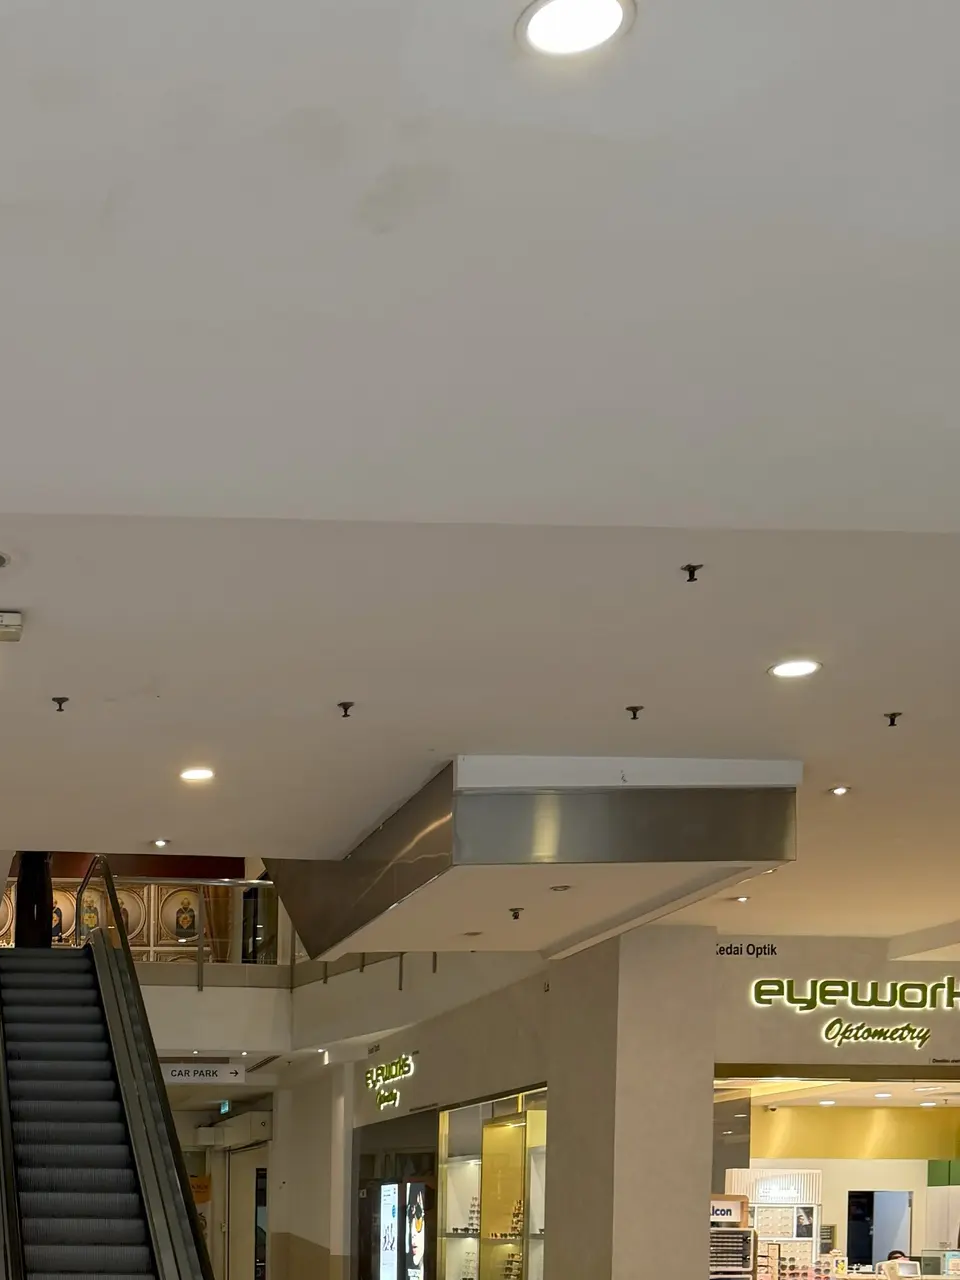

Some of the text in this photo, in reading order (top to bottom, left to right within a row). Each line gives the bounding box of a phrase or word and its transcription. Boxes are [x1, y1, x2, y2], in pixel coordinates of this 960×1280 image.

[746, 943, 778, 958] Optik
[824, 1017, 932, 1049] Optometry
[170, 1069, 219, 1078] CAR PARK
[710, 1205, 732, 1216] lcon
